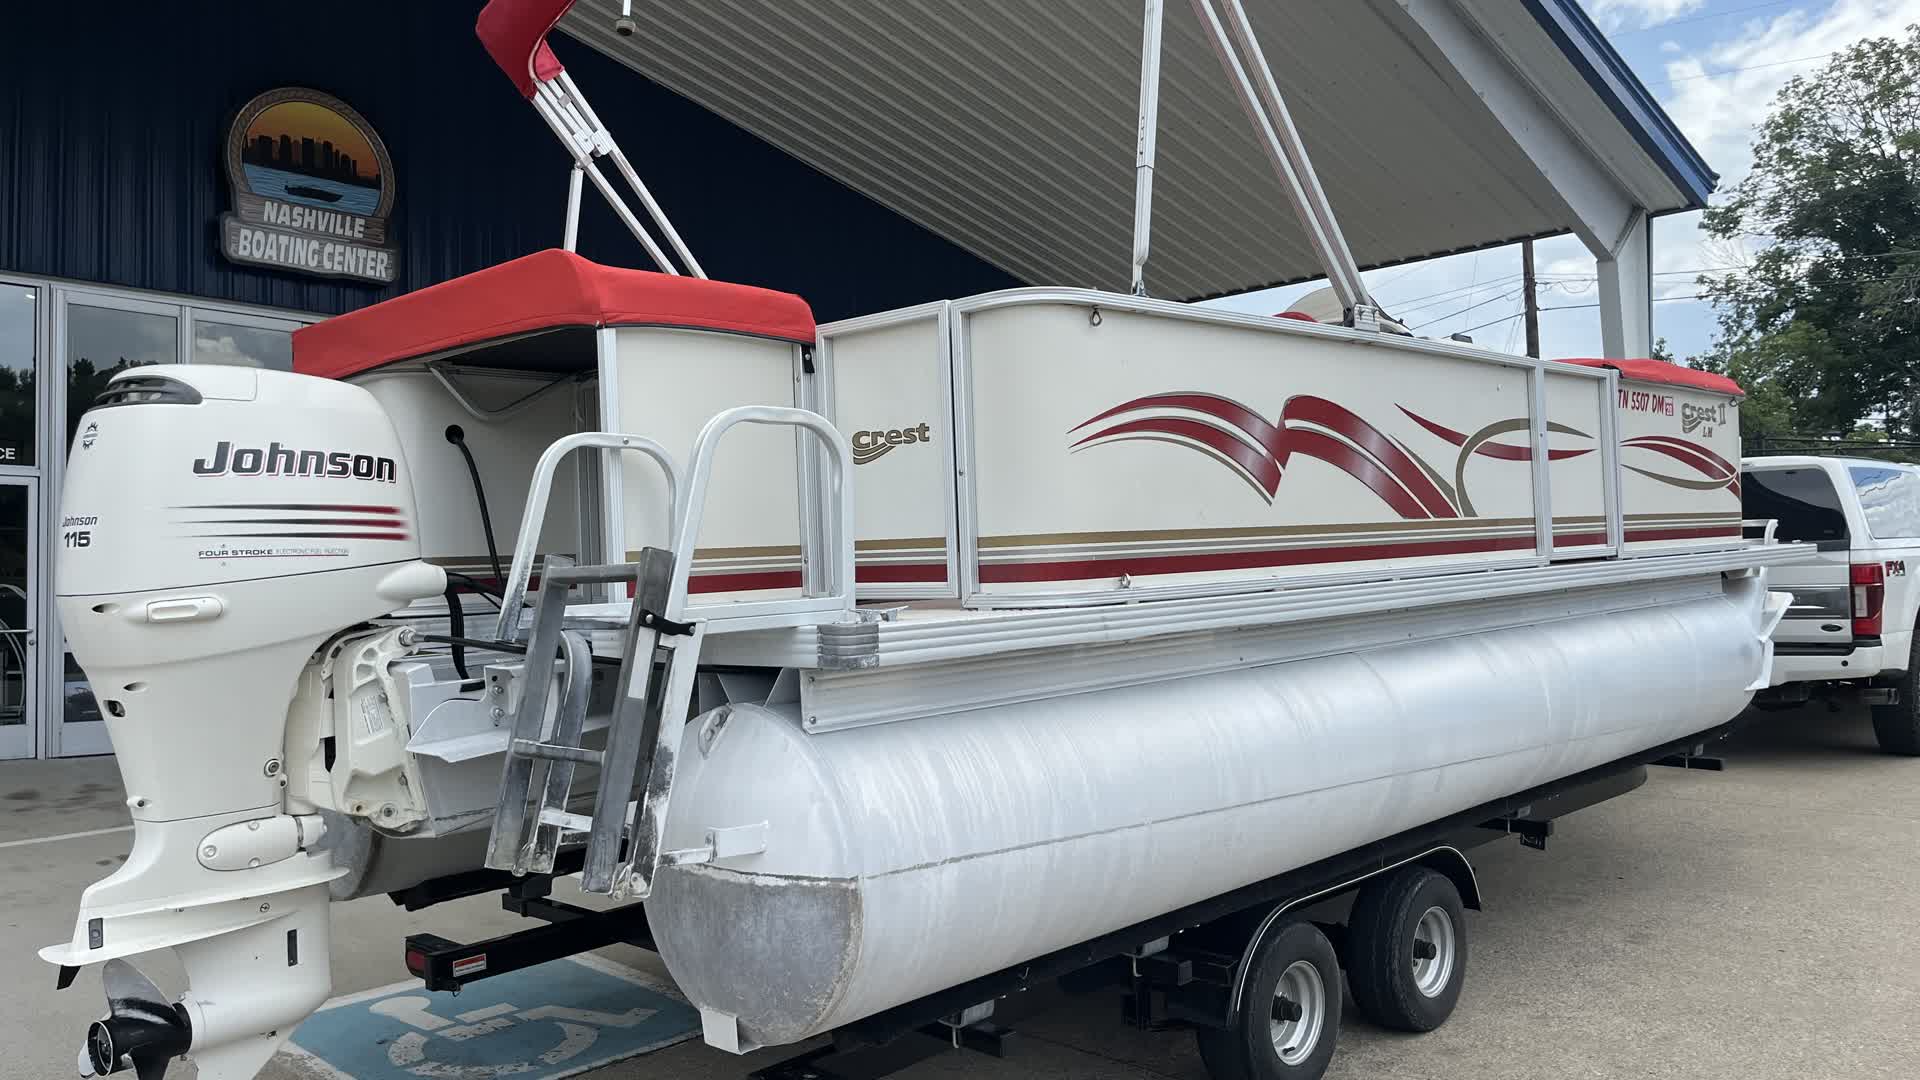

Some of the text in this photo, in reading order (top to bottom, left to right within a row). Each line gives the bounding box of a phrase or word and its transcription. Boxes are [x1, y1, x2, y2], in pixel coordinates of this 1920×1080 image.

[263, 200, 366, 239] NASHVILLE
[238, 228, 388, 278] BOATING CENTER
[1618, 389, 1665, 415] TN 5507 DM
[192, 440, 398, 484] Johnson
[61, 515, 98, 528] Johnson
[64, 531, 91, 548] 115
[198, 549, 229, 557] FOUR
[231, 548, 273, 557] STROKE
[1885, 560, 1906, 577] FX4
